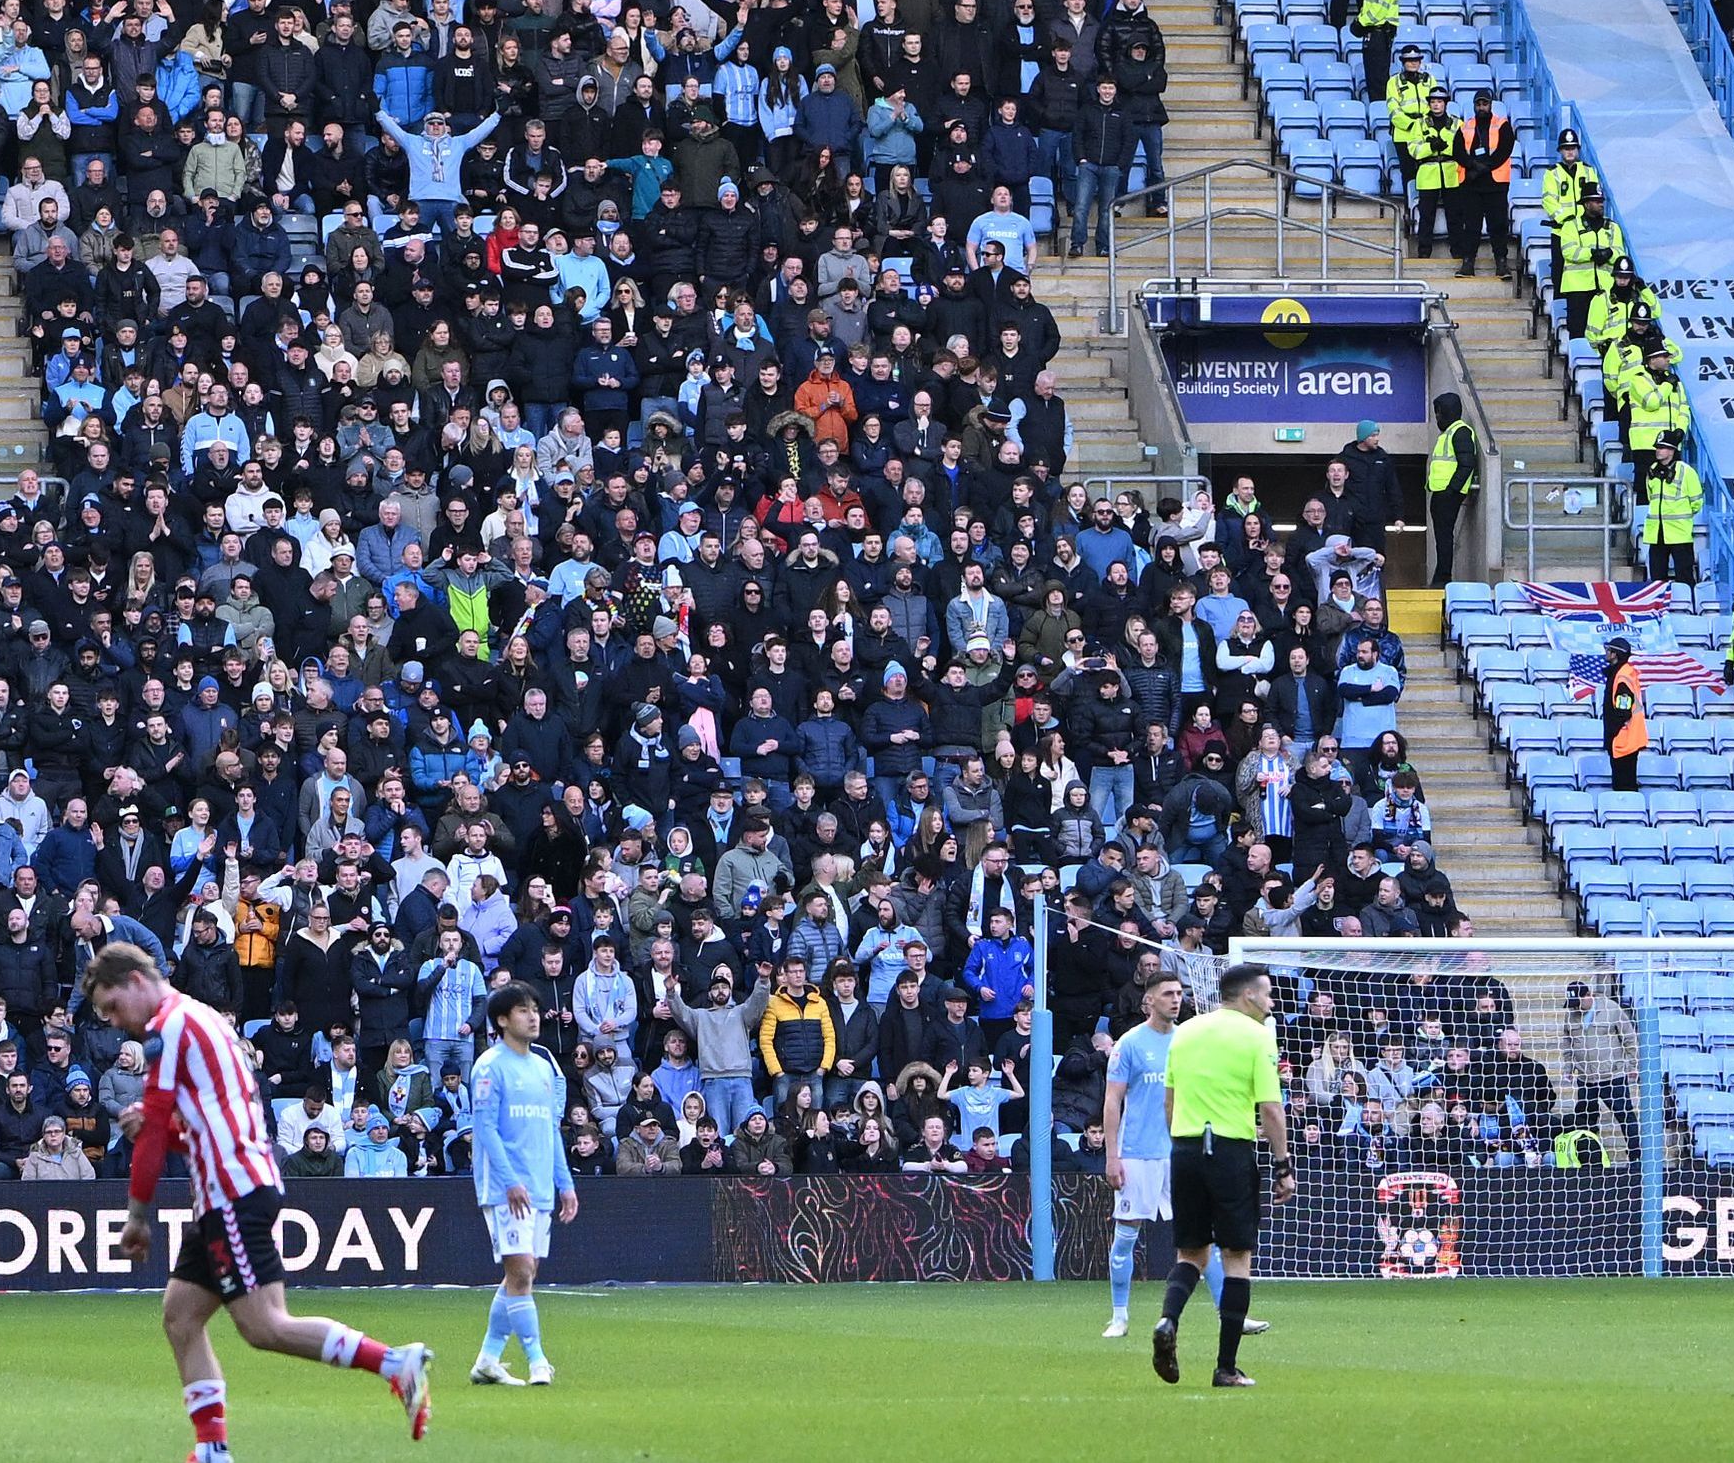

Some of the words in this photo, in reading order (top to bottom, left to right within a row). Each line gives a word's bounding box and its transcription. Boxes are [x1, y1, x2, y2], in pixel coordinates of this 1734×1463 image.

[987, 230, 1017, 240] monzo
[1177, 382, 1230, 398] Building
[1233, 382, 1281, 398] Society
[1297, 370, 1394, 395] arena
[1596, 622, 1643, 634] COVENTRY
[149, 1209, 435, 1275] TDAY
